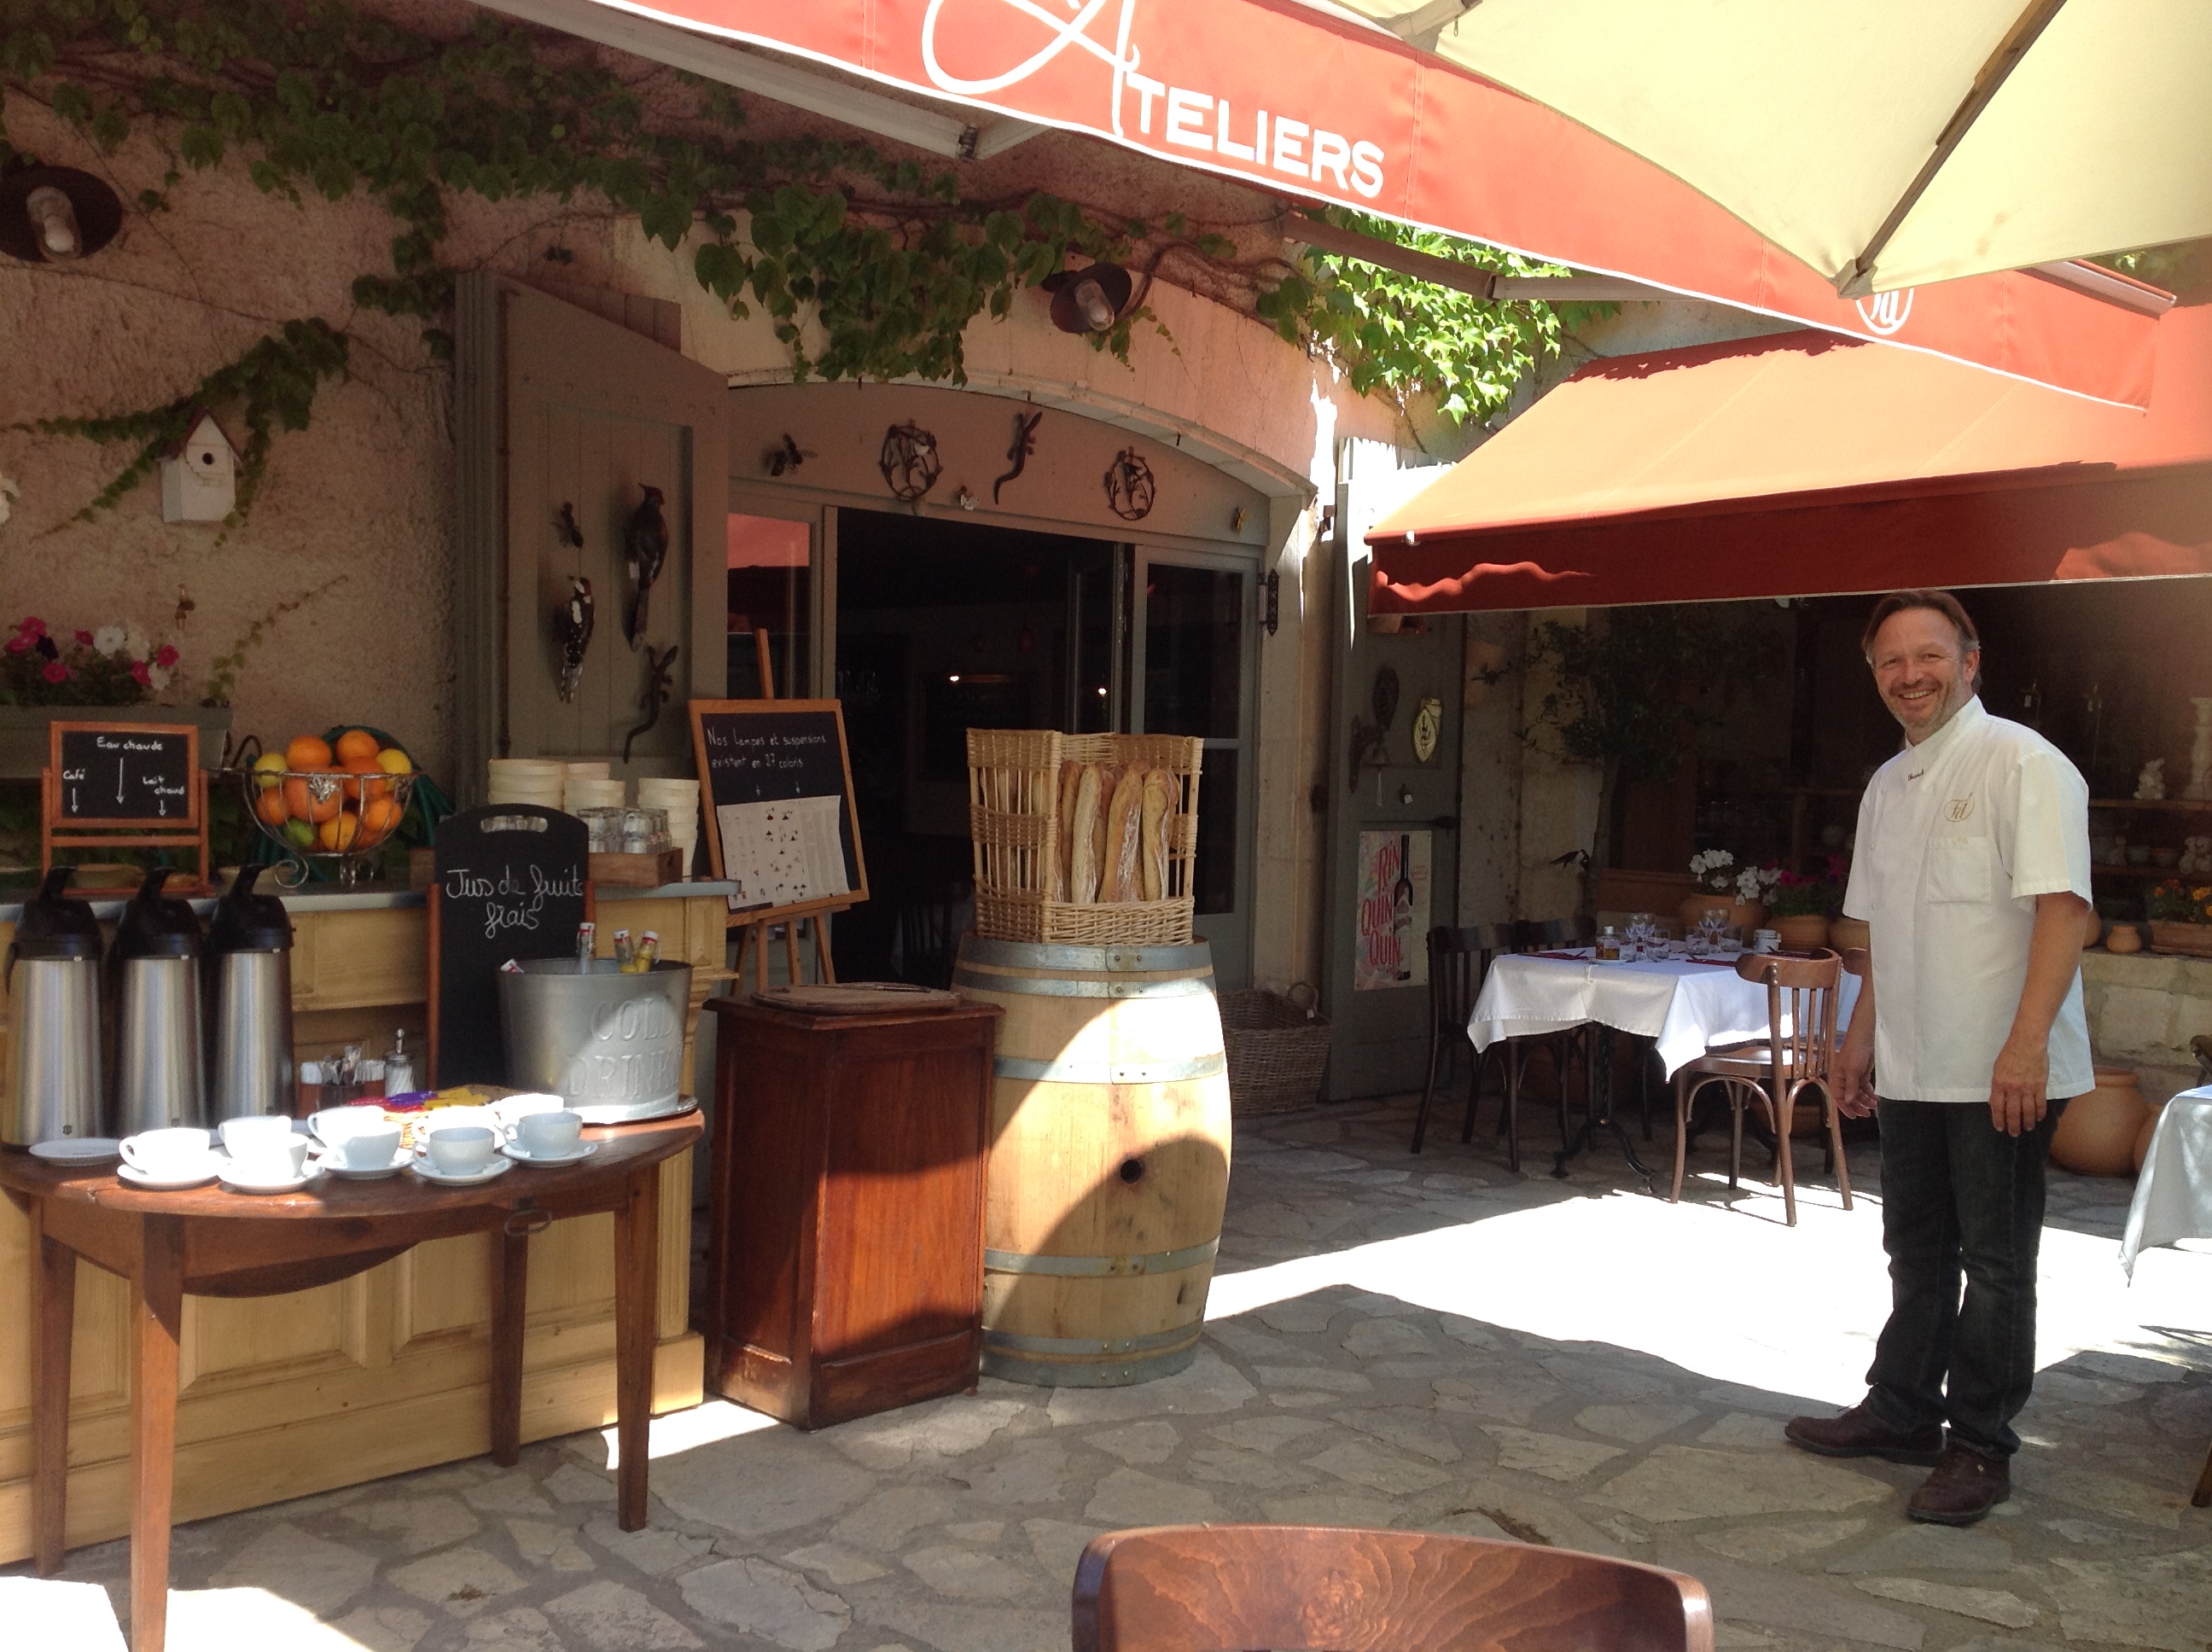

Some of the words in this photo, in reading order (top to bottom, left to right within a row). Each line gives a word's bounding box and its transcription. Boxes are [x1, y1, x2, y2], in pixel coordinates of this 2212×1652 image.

[96, 736, 119, 748] Eau
[123, 740, 163, 751] chaude
[707, 727, 728, 746] Nos
[770, 733, 780, 746] et
[752, 759, 761, 769] en
[62, 769, 85, 780] Café
[154, 786, 185, 795] chaud
[445, 868, 494, 899] Jus
[498, 865, 526, 896] de
[484, 901, 539, 939] frais
